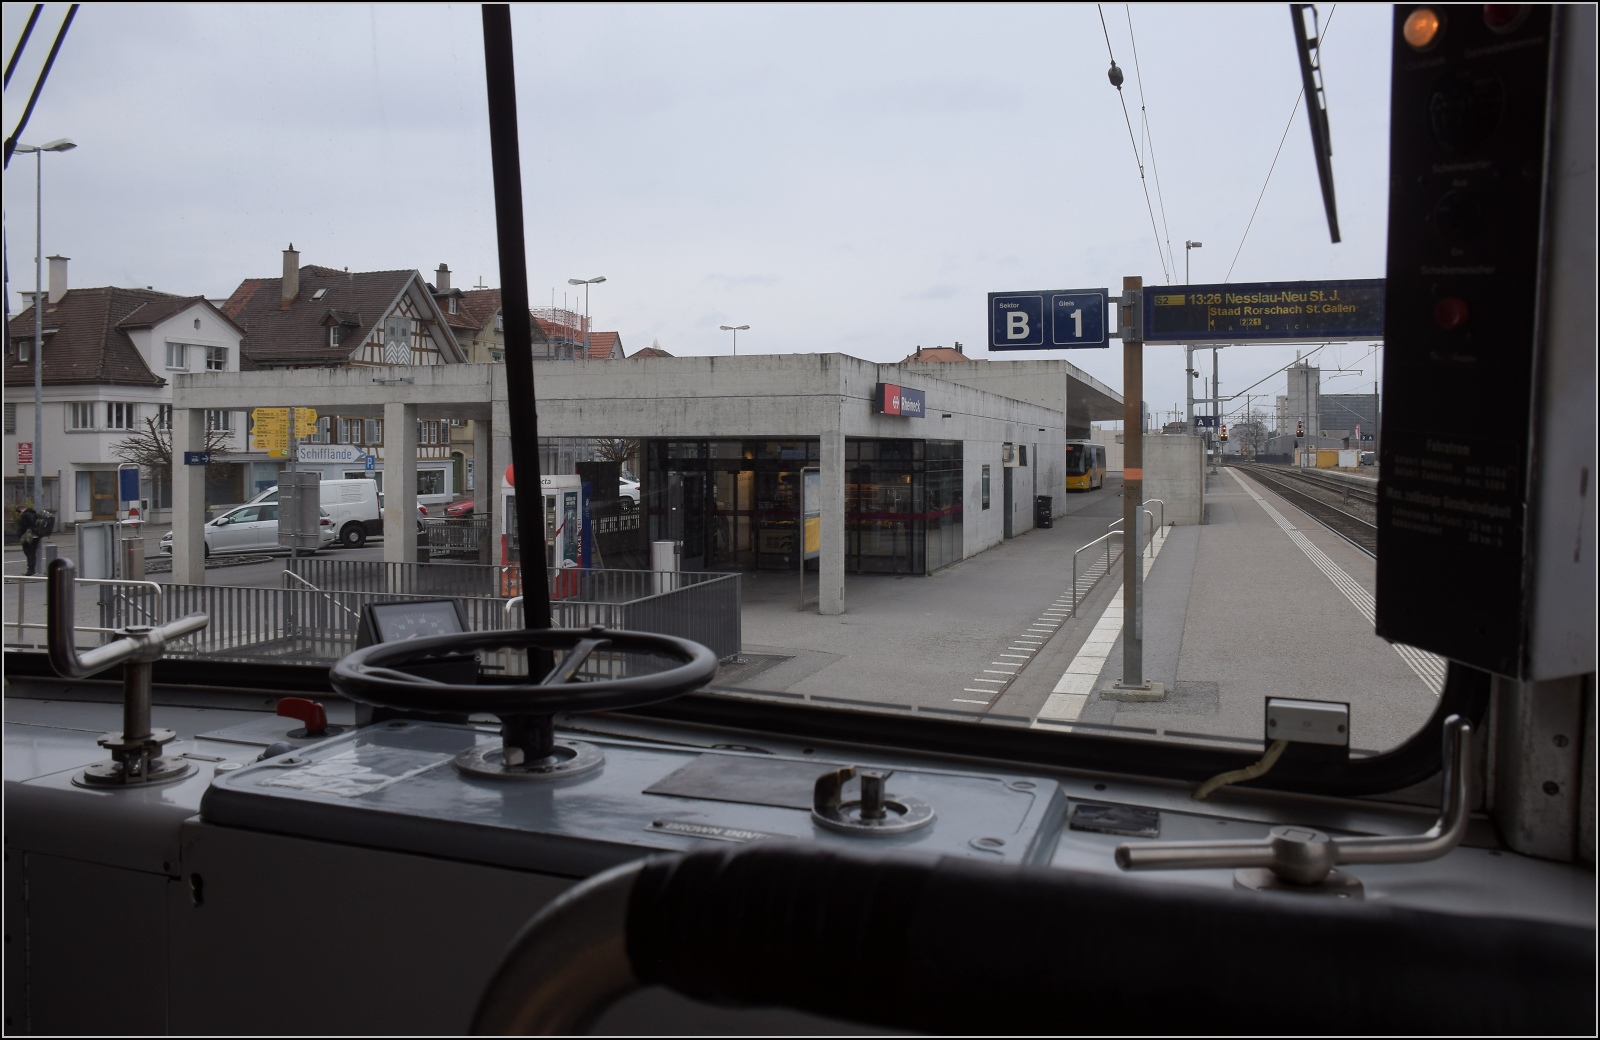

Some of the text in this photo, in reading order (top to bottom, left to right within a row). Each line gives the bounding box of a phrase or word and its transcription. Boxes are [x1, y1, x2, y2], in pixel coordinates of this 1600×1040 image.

[1156, 290, 1340, 305] S2 13:26 Nesslau-Neu St. J.
[1210, 304, 1356, 316] Staad Rorschach St. Gallen
[1006, 311, 1030, 340] B
[1070, 309, 1082, 338] 1
[902, 396, 920, 412] Rheineck
[300, 448, 352, 460] Schifflände
[665, 822, 723, 835] BROWN
